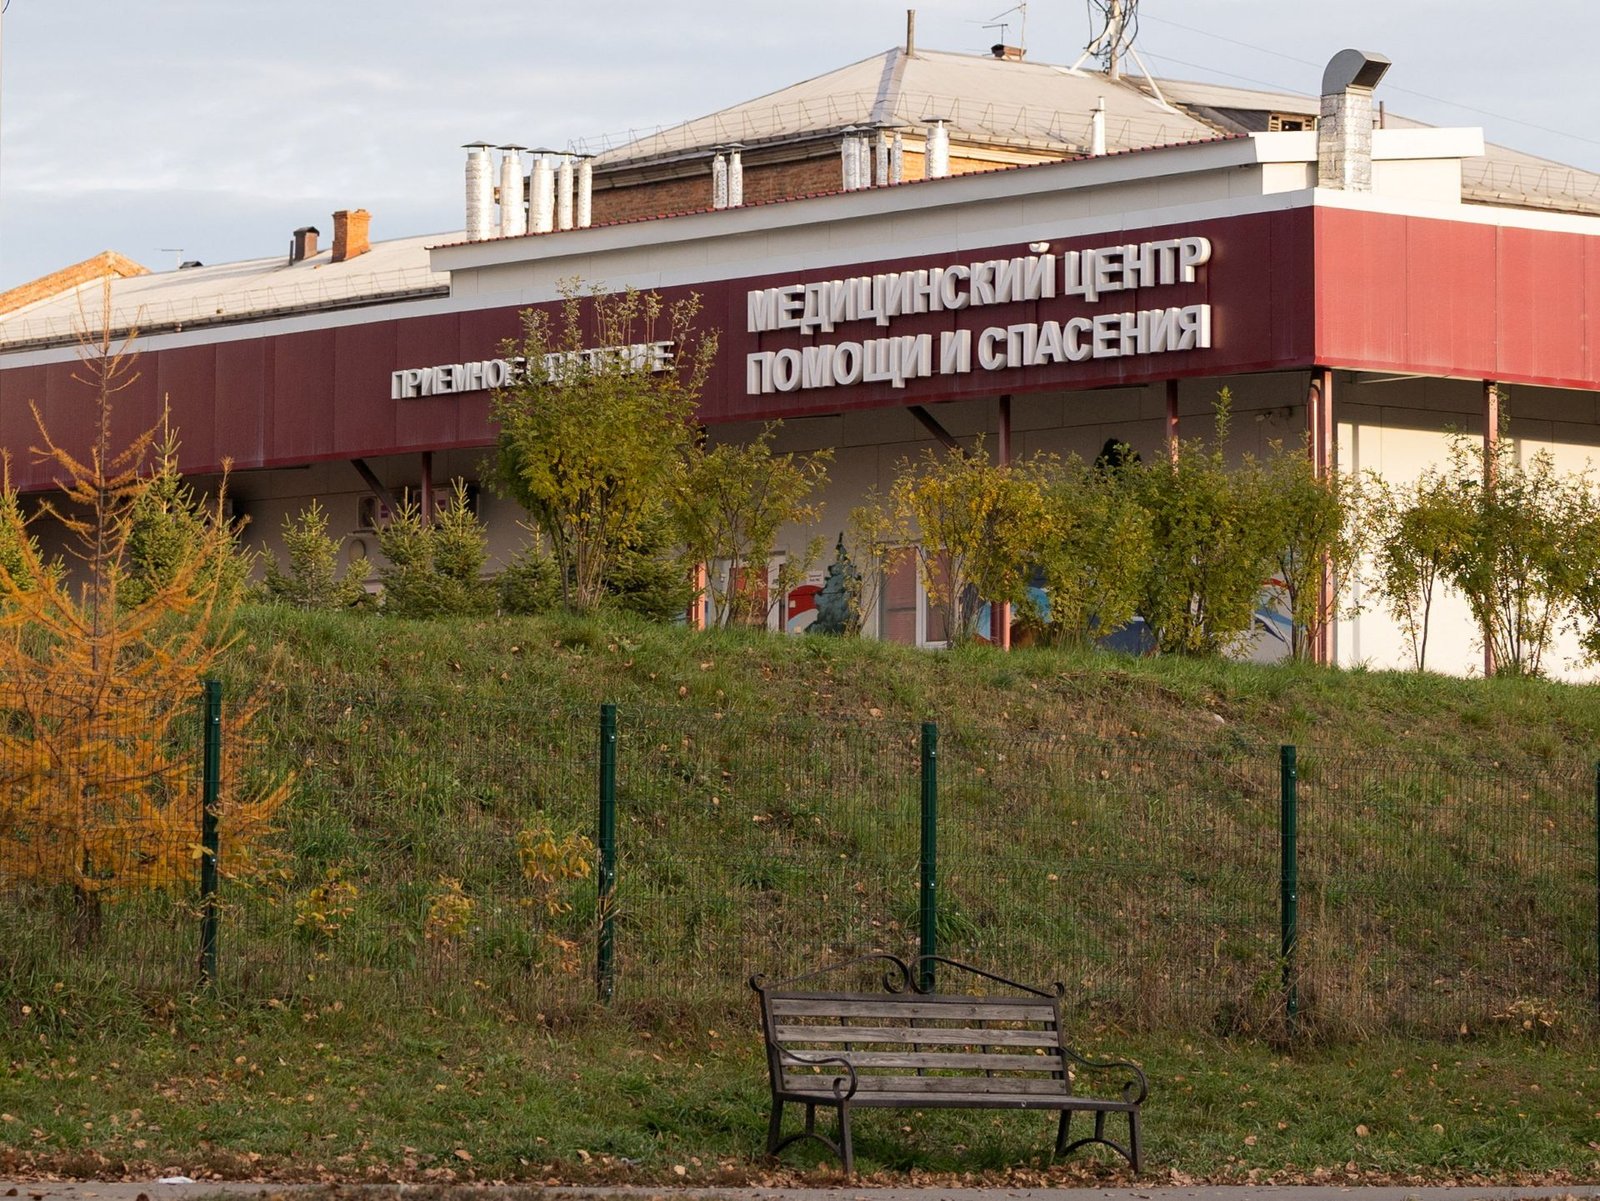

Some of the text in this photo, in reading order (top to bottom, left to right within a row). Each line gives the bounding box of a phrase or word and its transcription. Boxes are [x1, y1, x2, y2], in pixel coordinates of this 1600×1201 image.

[747, 236, 1212, 334] МЕДИЦИНСКИЙ ЦЕНТР
[746, 332, 933, 395] ПОМОЩИ
[940, 329, 972, 374] И
[978, 304, 1212, 371] СПАСЕНИЯ
